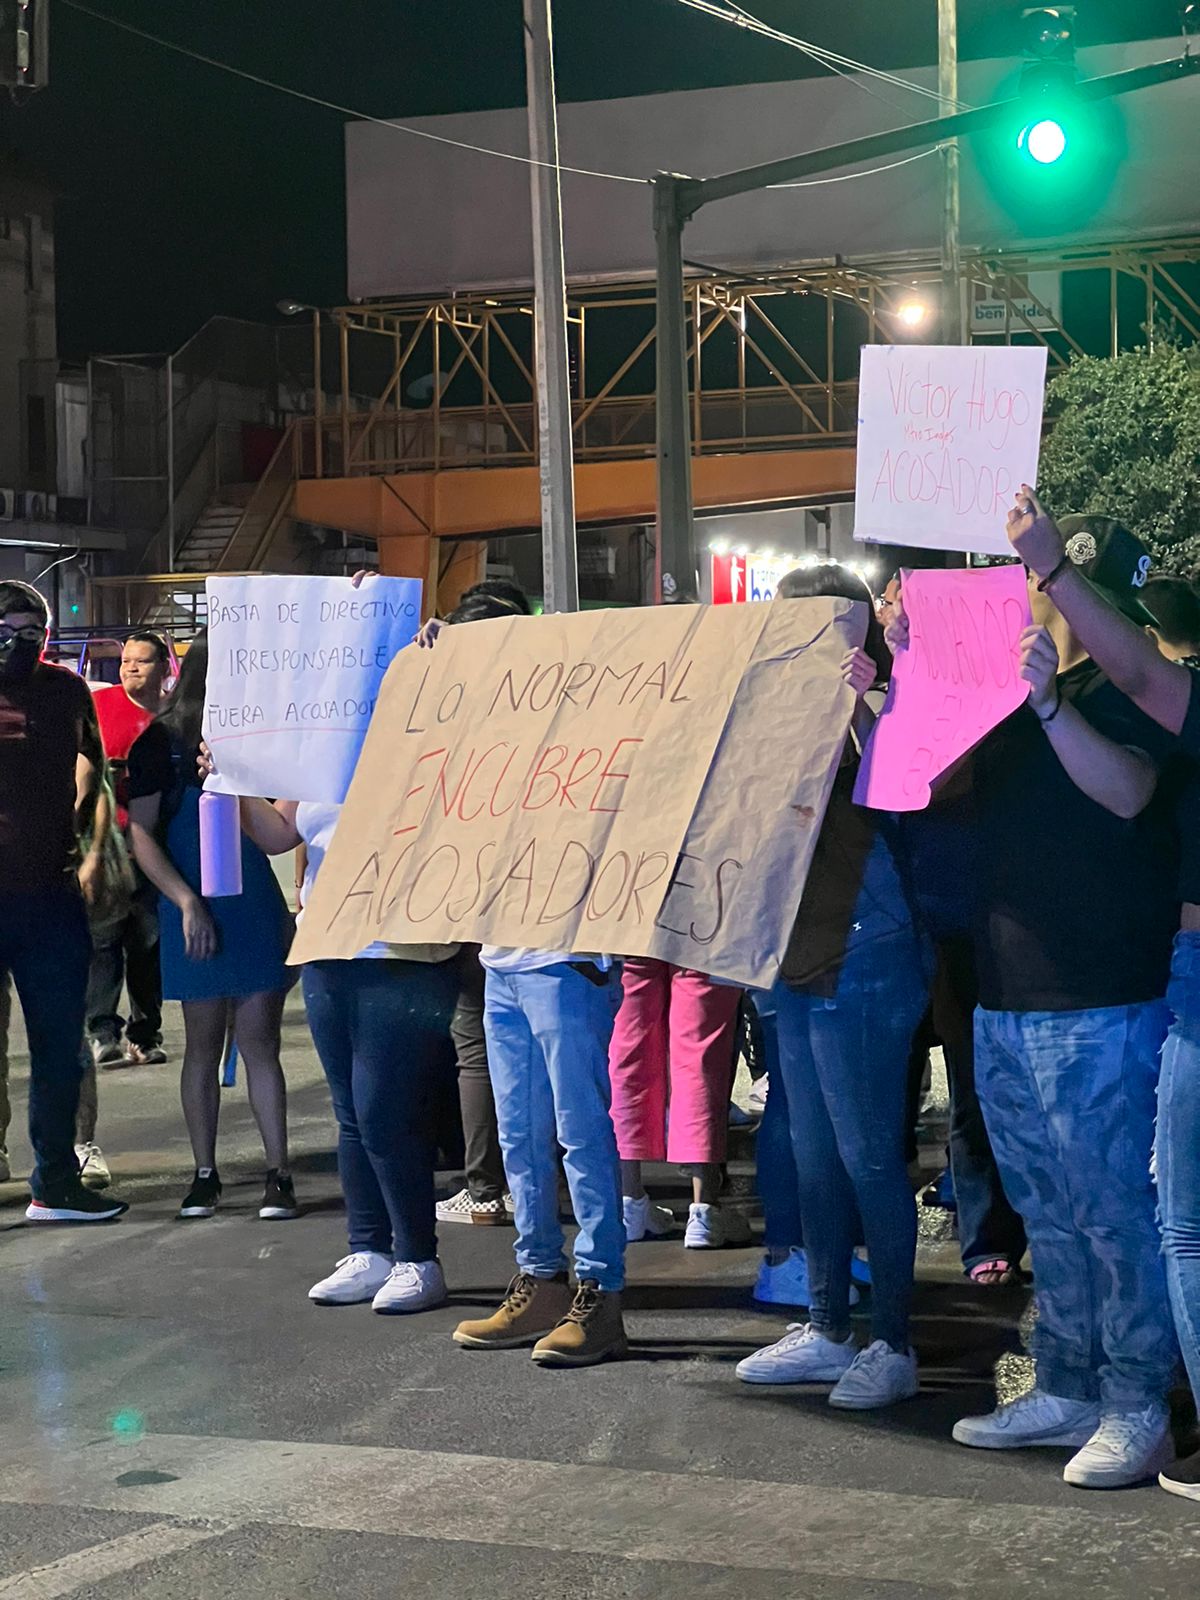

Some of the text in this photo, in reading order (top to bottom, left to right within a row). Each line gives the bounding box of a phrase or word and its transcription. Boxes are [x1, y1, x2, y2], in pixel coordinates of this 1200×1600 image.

[966, 352, 1030, 450] Hugo
[872, 449, 1012, 516] ACOSADOR
[210, 596, 416, 629] BASTA DE DIRECTIVO
[230, 645, 388, 676] IRRESPONSABLE
[488, 660, 693, 716] NORMAL
[209, 703, 265, 732] FUERA
[393, 738, 644, 836] ENCUBRE
[327, 837, 743, 945] ACOSADORES
